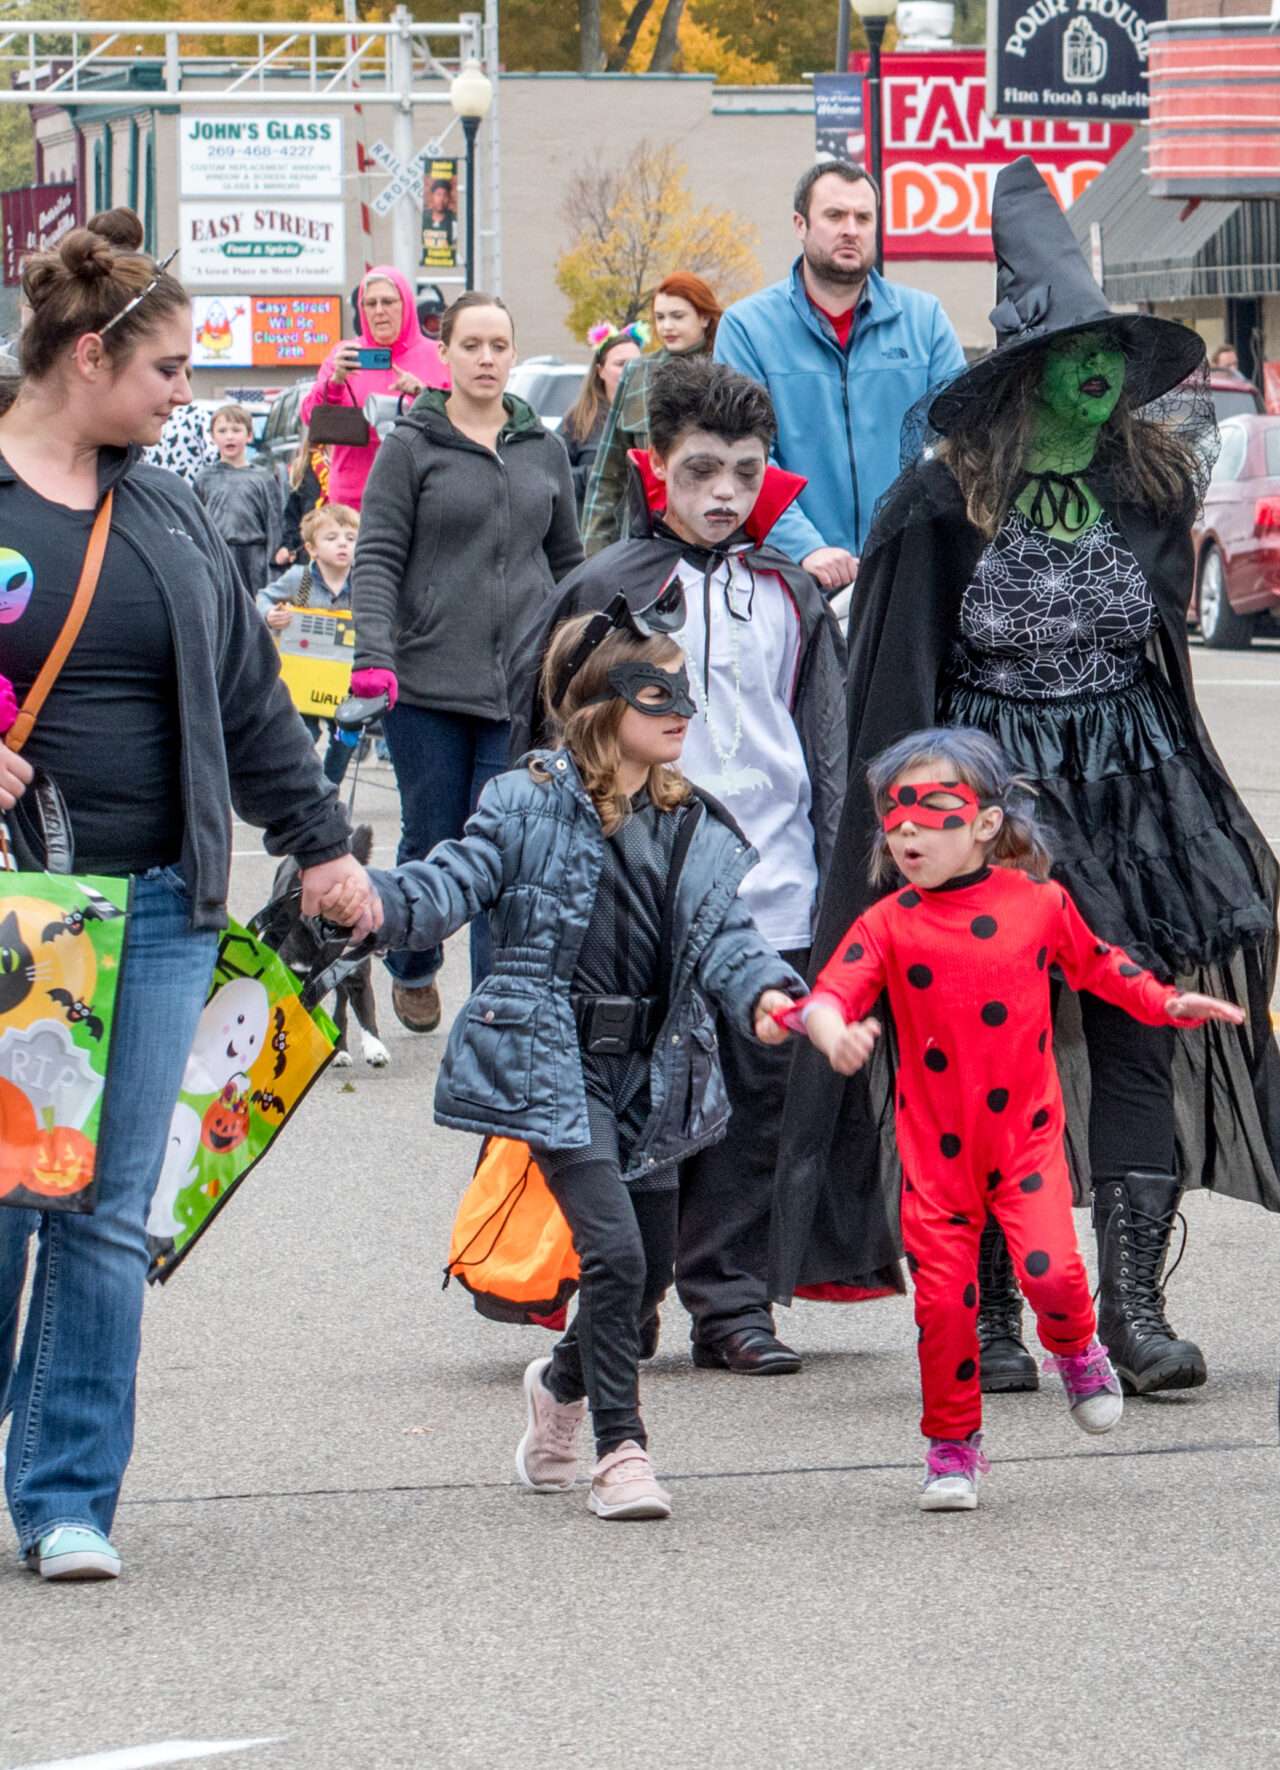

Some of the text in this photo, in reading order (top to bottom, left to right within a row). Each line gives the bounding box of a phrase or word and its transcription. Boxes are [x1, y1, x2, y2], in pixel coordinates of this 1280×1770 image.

[1004, 87, 1149, 109] fine food & spirit
[188, 120, 331, 141] JOHN'S GLASS
[207, 144, 315, 157] 269-468-4227
[885, 161, 1107, 236] DOL
[191, 209, 334, 243] EASY STREET
[226, 244, 299, 257] Food & Spirits
[256, 300, 330, 314] Easy Street
[269, 316, 314, 329] Will Be
[253, 332, 329, 344] Closed Sun
[11, 1049, 77, 1094] RIP
